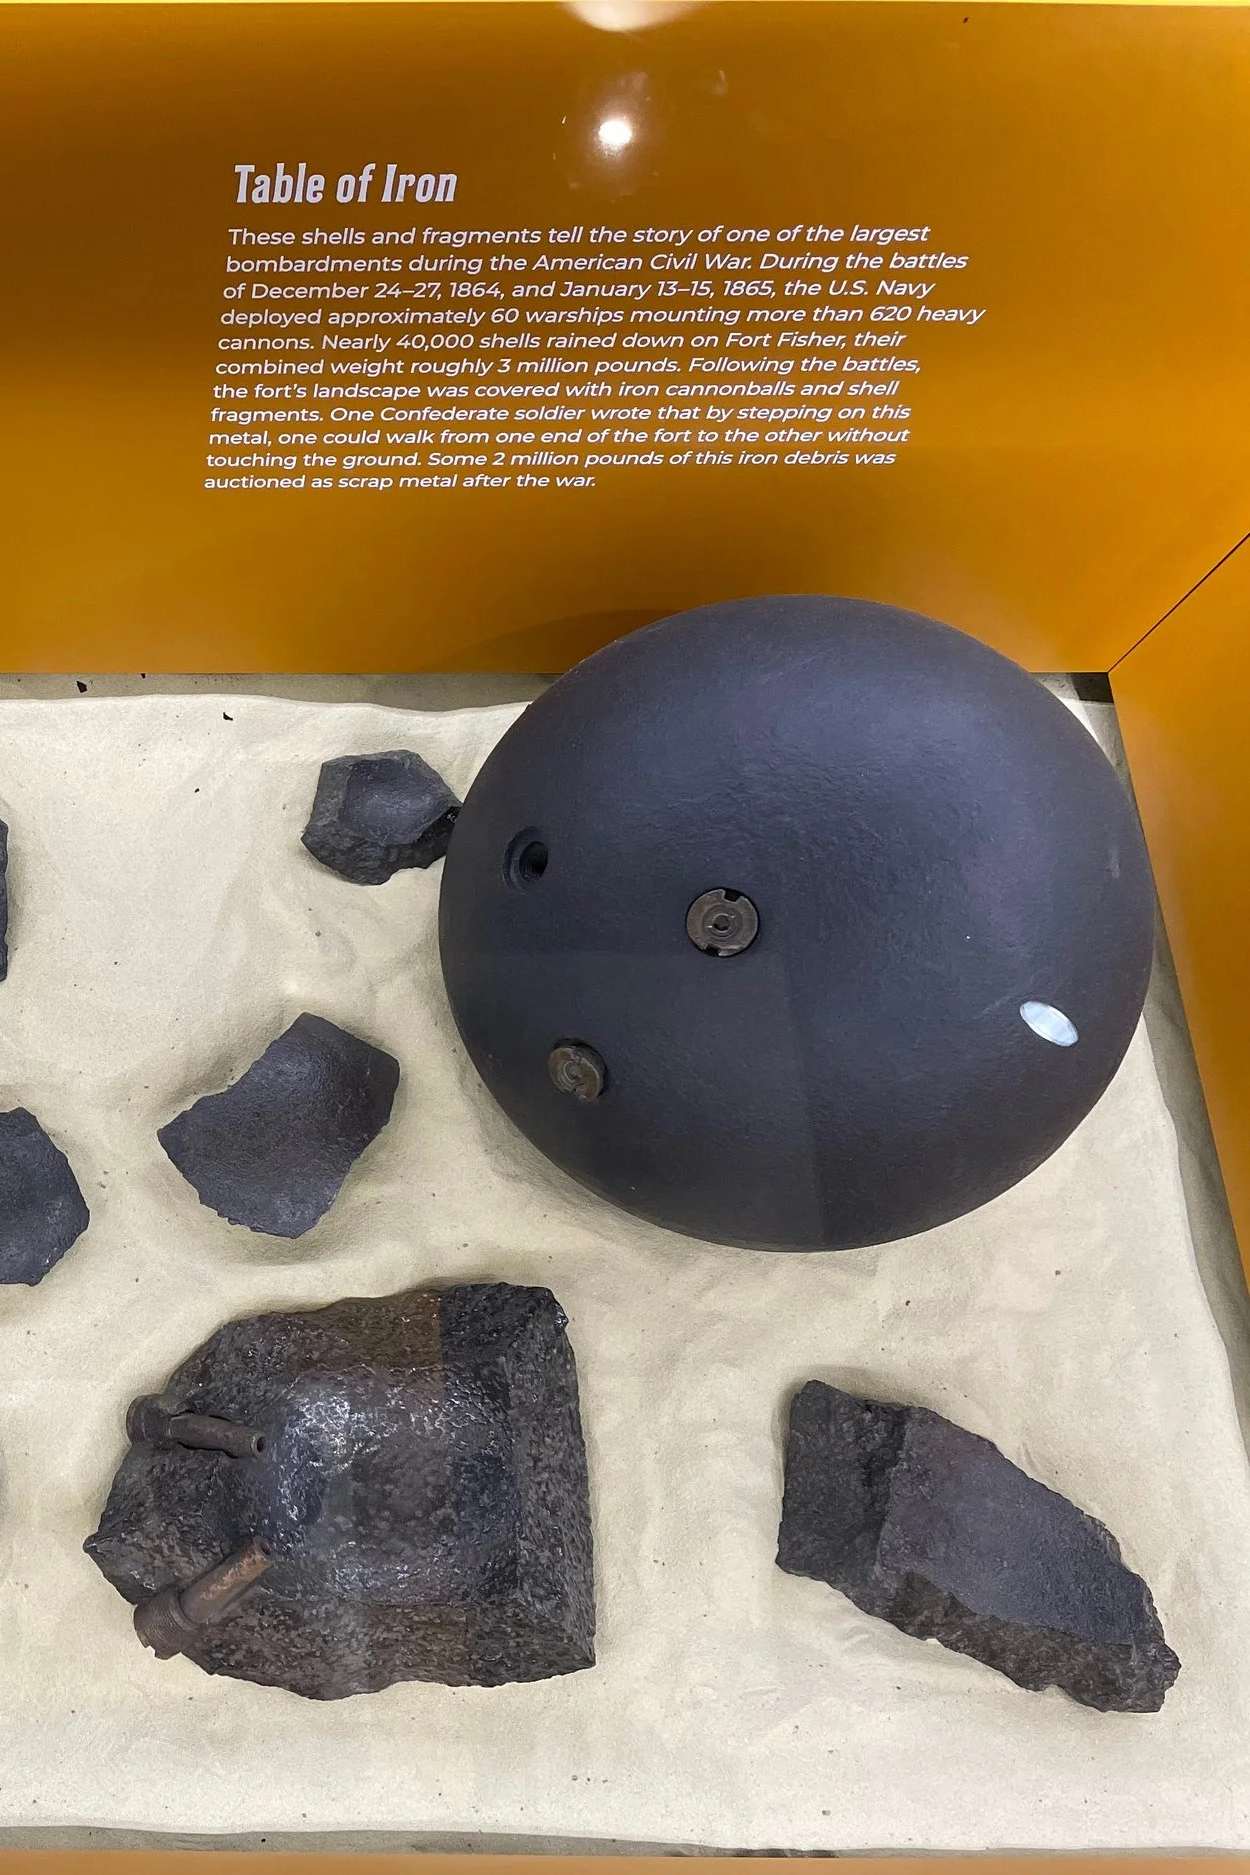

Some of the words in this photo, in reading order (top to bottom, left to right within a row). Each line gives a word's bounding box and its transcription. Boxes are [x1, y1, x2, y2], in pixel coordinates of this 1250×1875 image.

[235, 163, 324, 203] Table
[336, 164, 376, 202] of
[382, 164, 457, 202] Iron
[229, 228, 295, 244] These
[302, 228, 365, 244] shells
[372, 228, 416, 244] and
[423, 228, 541, 247] fragments
[549, 226, 583, 243] tell
[590, 226, 627, 242] the
[633, 228, 693, 246] story
[698, 226, 724, 242] of
[726, 230, 770, 242] one
[777, 225, 804, 241] of
[806, 225, 844, 241] the
[850, 225, 930, 245] largest
[227, 256, 402, 272] bombardments
[409, 255, 482, 274] during
[490, 255, 527, 270] the
[532, 254, 642, 270] American
[650, 253, 698, 269] Civil
[706, 254, 751, 269] War.
[760, 252, 839, 272] During
[846, 252, 883, 268] the
[889, 252, 968, 268] battles
[224, 283, 246, 298] of
[252, 283, 369, 298] December
[450, 282, 504, 300] 1864,
[512, 281, 556, 296] and
[560, 282, 652, 300] January
[724, 281, 775, 298] 1865,
[785, 280, 821, 295] the
[829, 280, 868, 295] U.S.
[876, 280, 935, 298] Navy
[221, 309, 322, 328] deployed
[328, 308, 486, 327] approximately
[492, 308, 519, 323] 60
[526, 307, 624, 326] warships
[630, 306, 740, 325] mounting
[747, 310, 806, 321] more
[813, 306, 863, 321] than
[870, 306, 912, 321] 620
[917, 306, 986, 324] heavy
[218, 338, 314, 350] cannons.
[322, 334, 391, 352] Nearly
[396, 334, 474, 351] 40,000
[479, 333, 541, 348] shells
[547, 333, 617, 348] rained
[622, 333, 684, 347] down
[691, 336, 718, 347] on
[726, 333, 772, 347] Fort
[777, 332, 846, 349] Fisher,
[854, 331, 906, 346] their
[216, 359, 324, 374] combined
[331, 359, 404, 376] weight
[411, 358, 494, 376] roughly
[498, 359, 511, 372] 3
[517, 358, 588, 372] million
[594, 358, 680, 375] pounds.
[689, 357, 794, 375] Following
[801, 357, 837, 371] the
[842, 356, 920, 373] battles,
[214, 384, 248, 398] the
[314, 383, 420, 400] landscape
[427, 386, 469, 397] was
[475, 382, 560, 397] covered
[566, 382, 612, 396] with
[619, 382, 659, 396] iron
[666, 381, 796, 396] cannonballs
[801, 381, 844, 395] and
[847, 381, 900, 395] shell
[210, 431, 271, 446] metal,
[278, 434, 317, 444] one
[323, 430, 380, 444] could
[386, 430, 434, 443] walk
[440, 430, 489, 443] from
[496, 433, 535, 443] one
[541, 429, 582, 442] end
[587, 429, 611, 442] of
[614, 429, 648, 442] the
[654, 428, 692, 442] fort
[698, 430, 718, 442] to
[725, 428, 759, 442] the
[765, 428, 823, 442] other
[828, 428, 910, 442] without
[206, 453, 296, 469] touching
[304, 453, 337, 466] the
[343, 452, 421, 469] ground.
[428, 453, 487, 465] Some
[492, 452, 505, 465] 2
[511, 452, 578, 465] million
[584, 451, 664, 468] pounds
[670, 451, 693, 464] of
[696, 451, 733, 464] this
[738, 451, 778, 464] iron
[784, 451, 849, 464] debris
[856, 454, 896, 464] was
